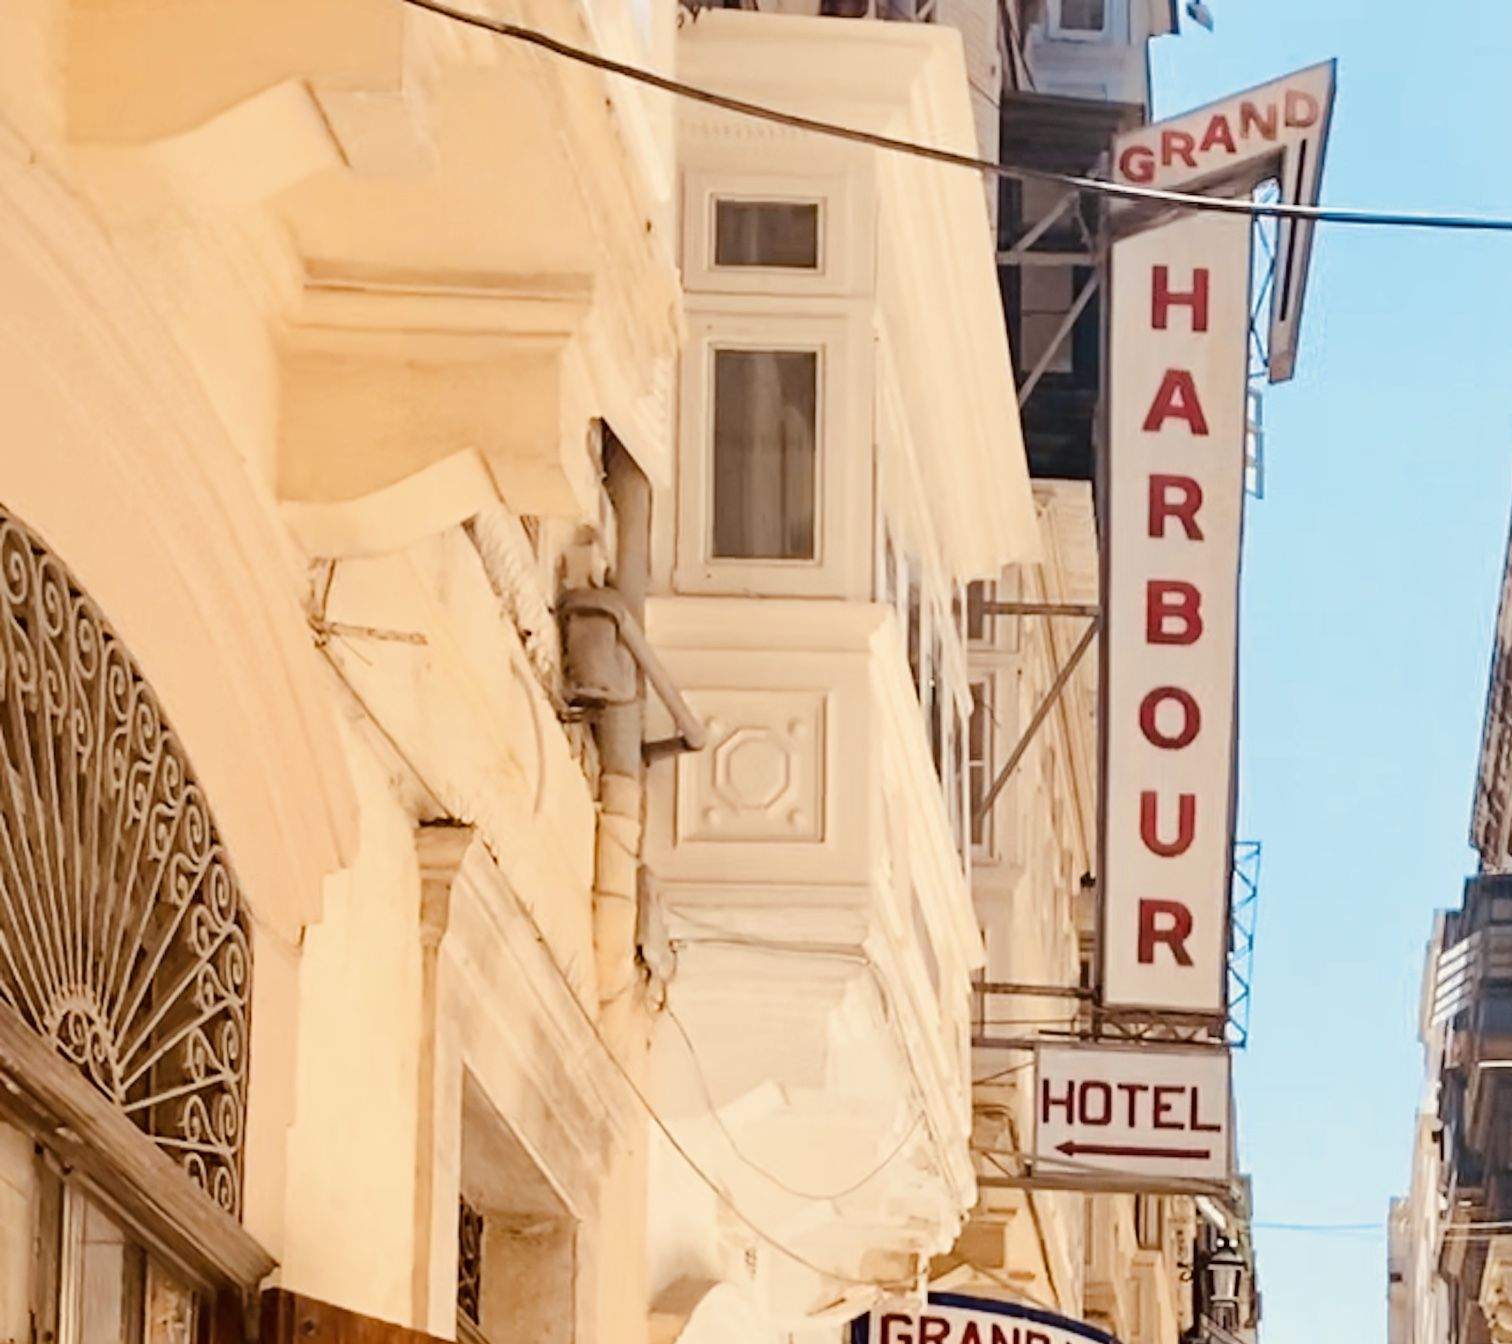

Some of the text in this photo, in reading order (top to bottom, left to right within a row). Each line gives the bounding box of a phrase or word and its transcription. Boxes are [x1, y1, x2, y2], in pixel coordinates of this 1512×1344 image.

[1119, 90, 1319, 183] GRAND
[1137, 264, 1210, 967] HARBOUR
[1042, 1078, 1221, 1133] HOTEL
